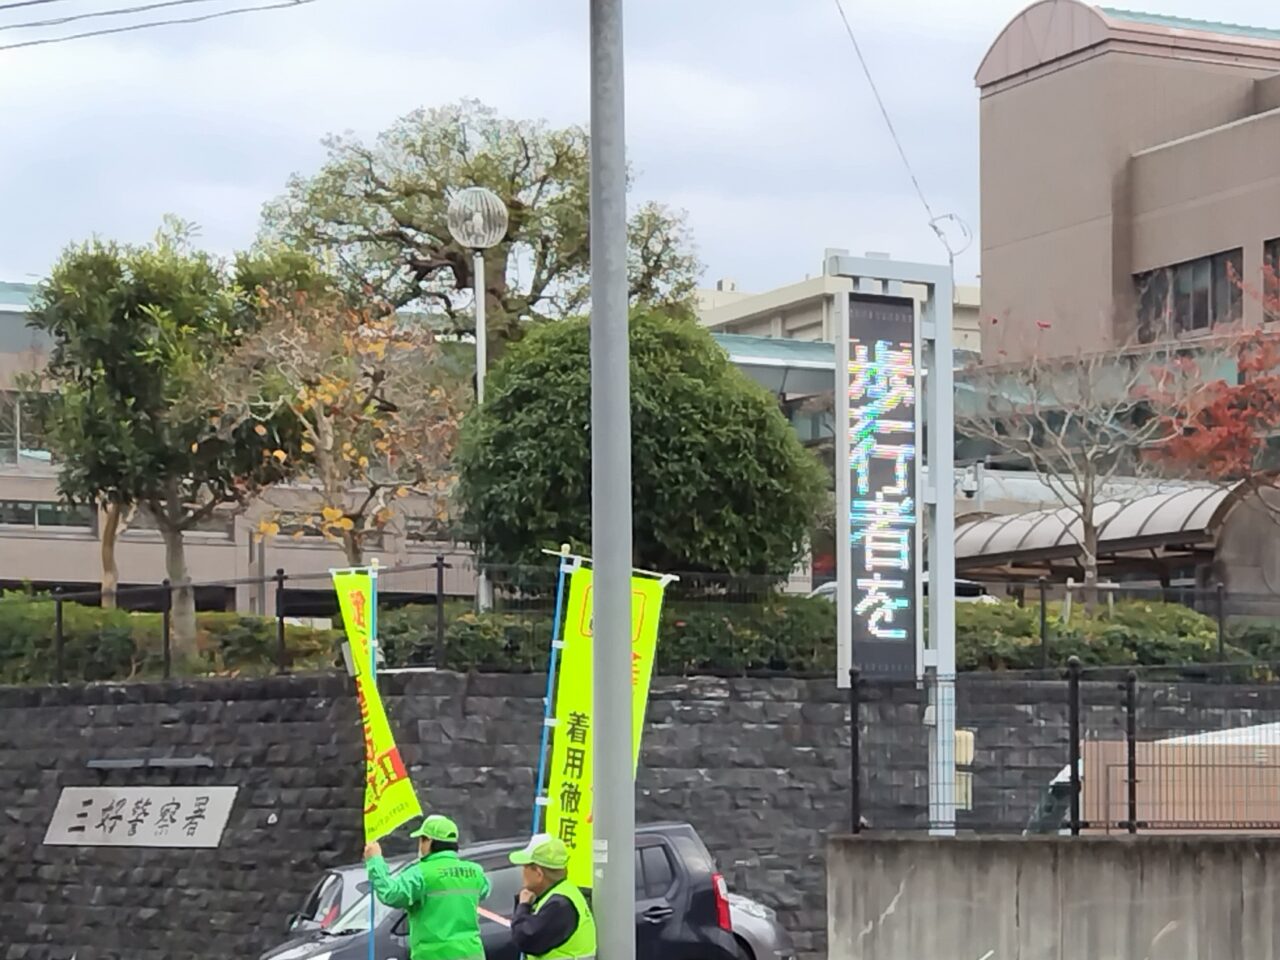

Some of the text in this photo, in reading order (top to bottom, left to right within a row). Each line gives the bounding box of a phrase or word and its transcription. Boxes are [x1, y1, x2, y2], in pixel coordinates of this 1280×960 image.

[67, 796, 210, 837] 三好警察署
